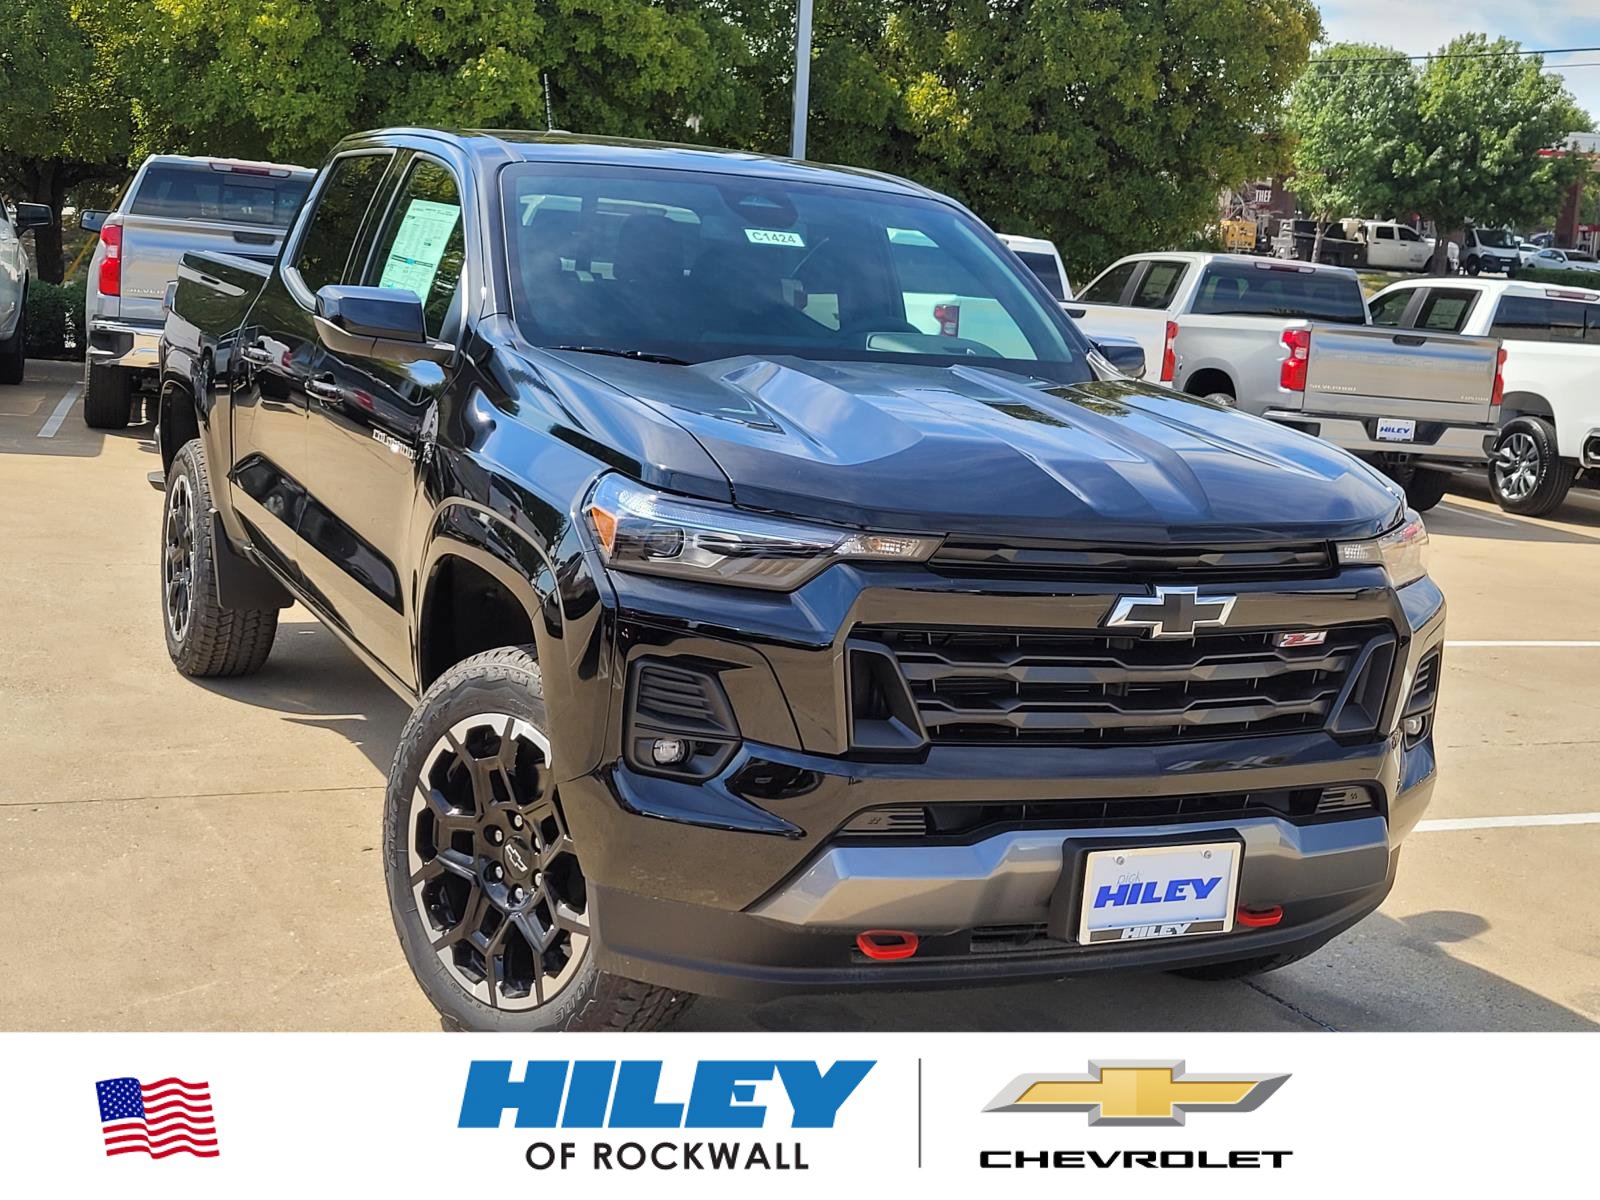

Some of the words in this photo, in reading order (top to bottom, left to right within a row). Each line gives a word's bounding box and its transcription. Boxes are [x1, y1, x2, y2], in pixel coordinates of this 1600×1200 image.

[752, 231, 796, 244] C1424
[1379, 426, 1410, 434] HILEY
[1093, 877, 1222, 909] HILEY
[1120, 923, 1191, 940] HILEY
